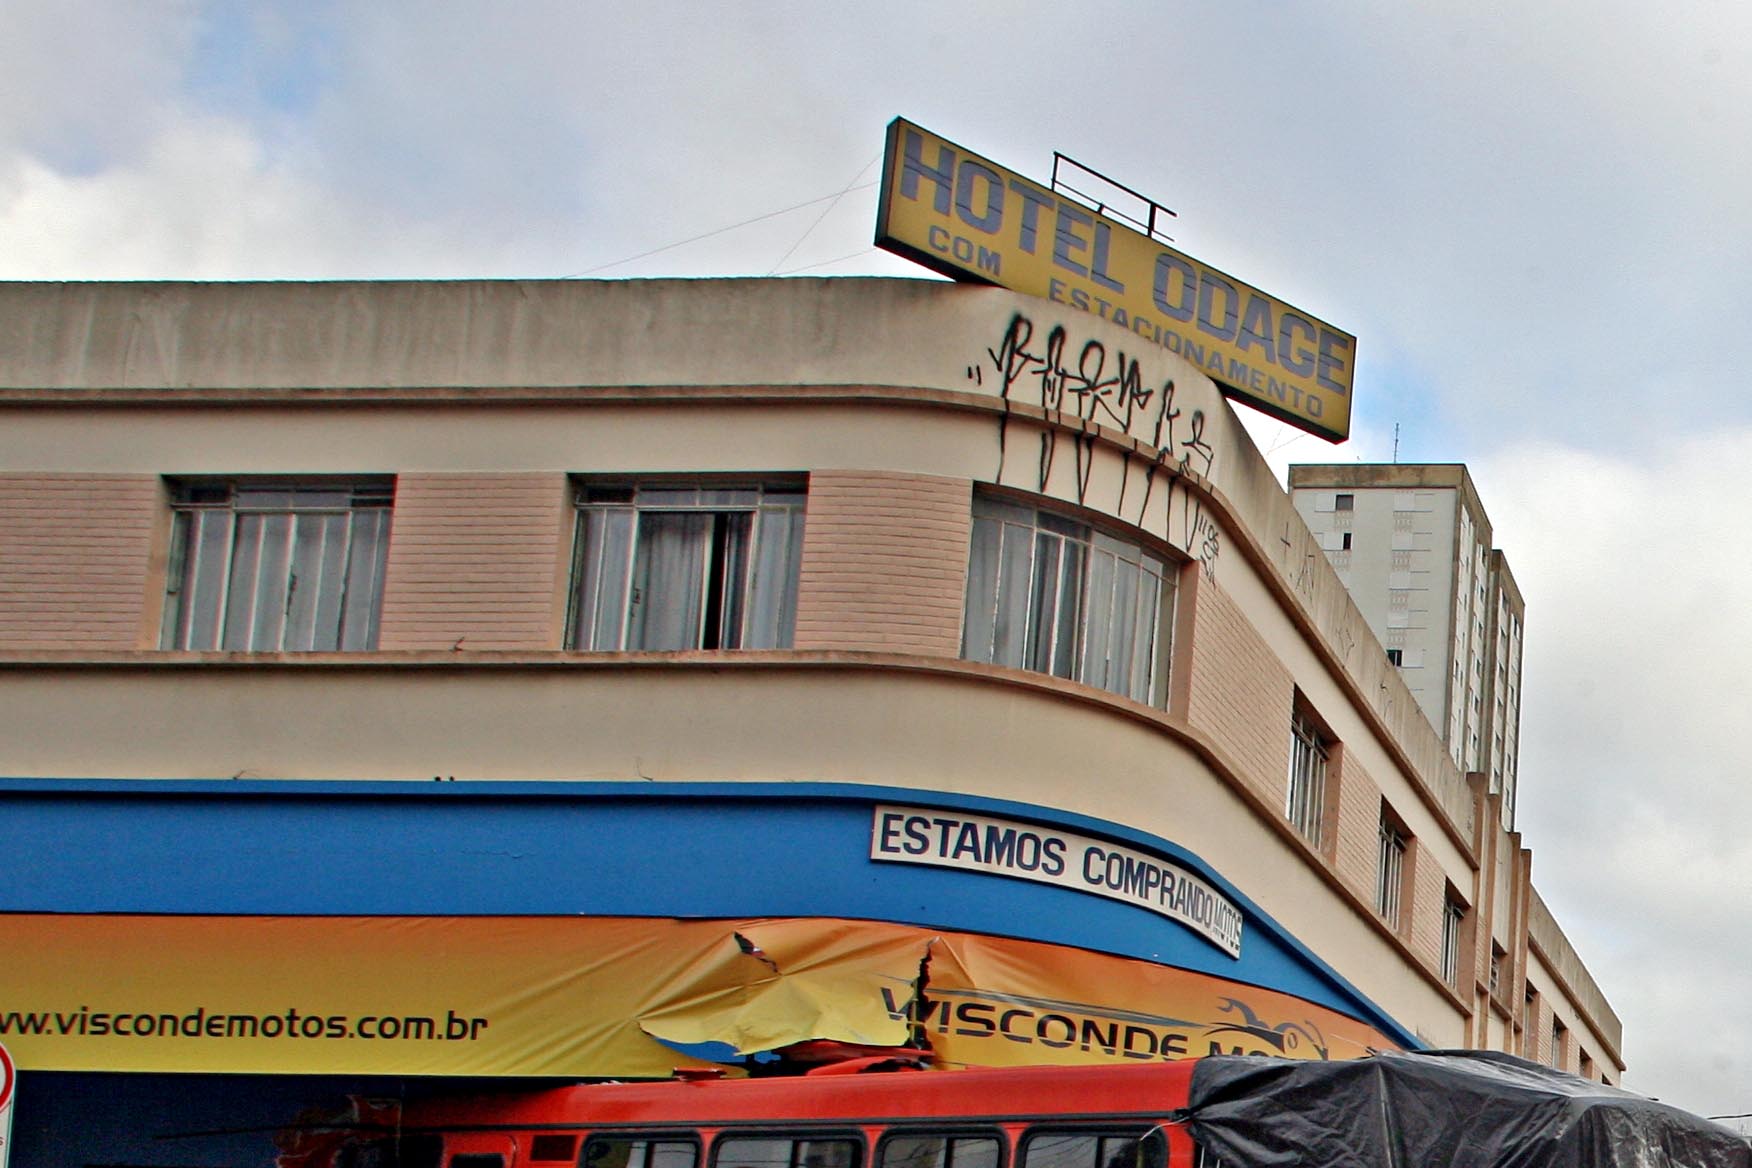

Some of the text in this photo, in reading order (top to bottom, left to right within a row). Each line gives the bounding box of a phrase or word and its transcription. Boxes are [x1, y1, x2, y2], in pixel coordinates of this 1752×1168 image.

[900, 130, 1349, 395] HOTEL ODAGE
[928, 224, 1324, 419] COM ESTACIONAMENTO
[880, 813, 1067, 877] ESTAMOS
[1082, 846, 1213, 928] COMPRANDO
